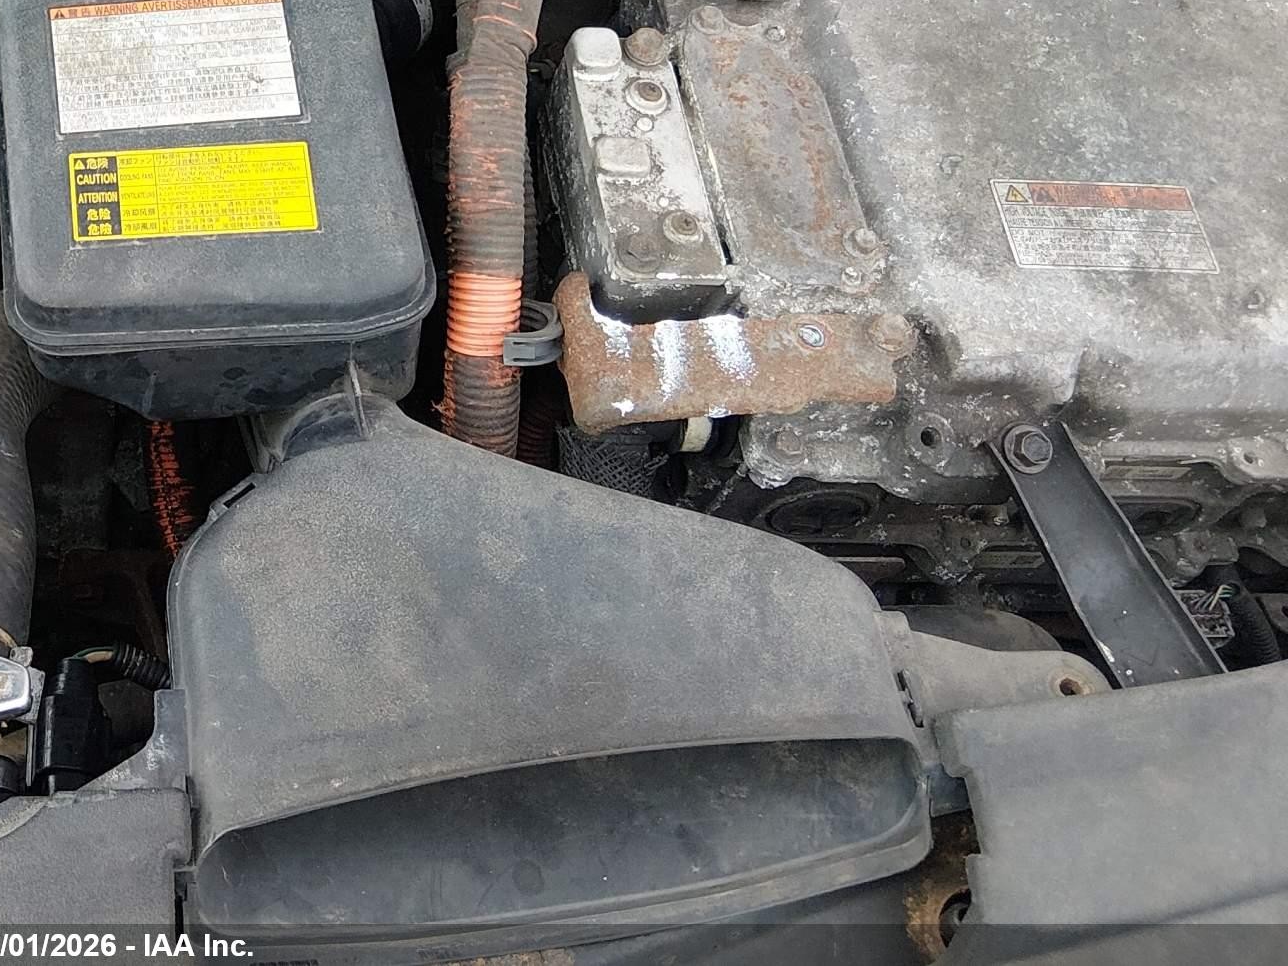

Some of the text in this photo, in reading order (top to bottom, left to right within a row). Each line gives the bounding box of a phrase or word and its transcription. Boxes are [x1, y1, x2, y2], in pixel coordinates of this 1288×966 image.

[95, 3, 139, 16] WARNING
[77, 172, 117, 185] CAUTION
[78, 191, 119, 205] ATTENTION
